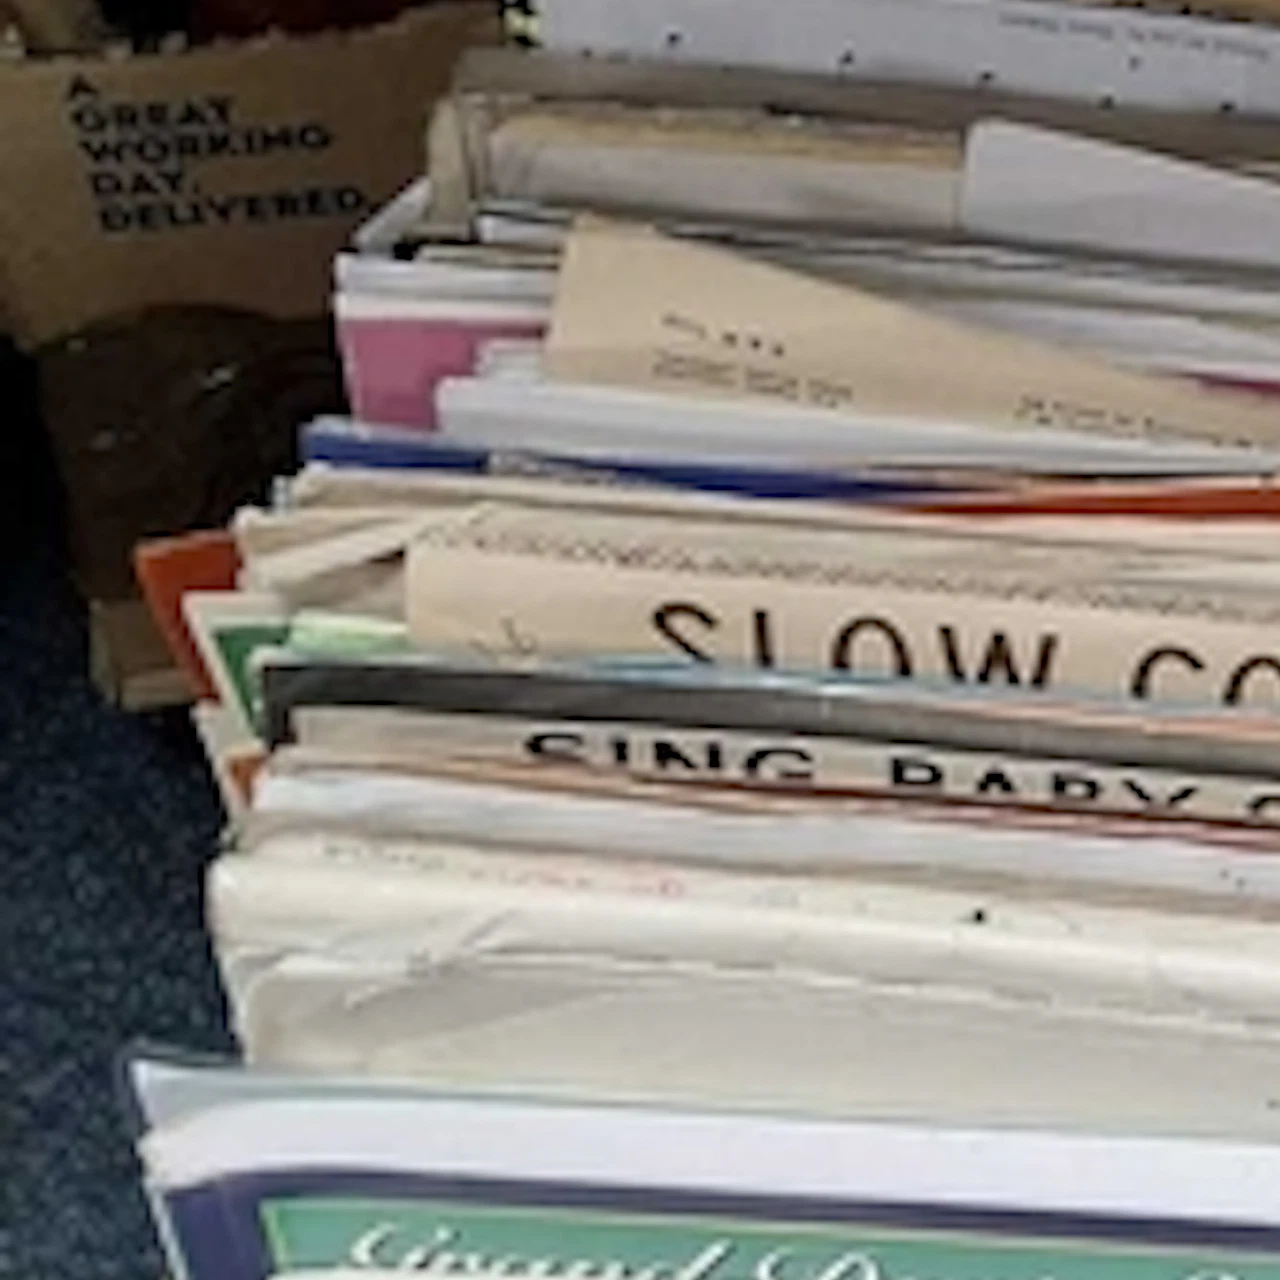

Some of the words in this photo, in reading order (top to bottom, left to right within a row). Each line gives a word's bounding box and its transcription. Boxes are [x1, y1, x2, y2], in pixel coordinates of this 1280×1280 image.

[67, 74, 97, 100] A
[71, 96, 233, 132] GREAT
[79, 124, 332, 163] WORKING
[654, 601, 1058, 690] SLOW
